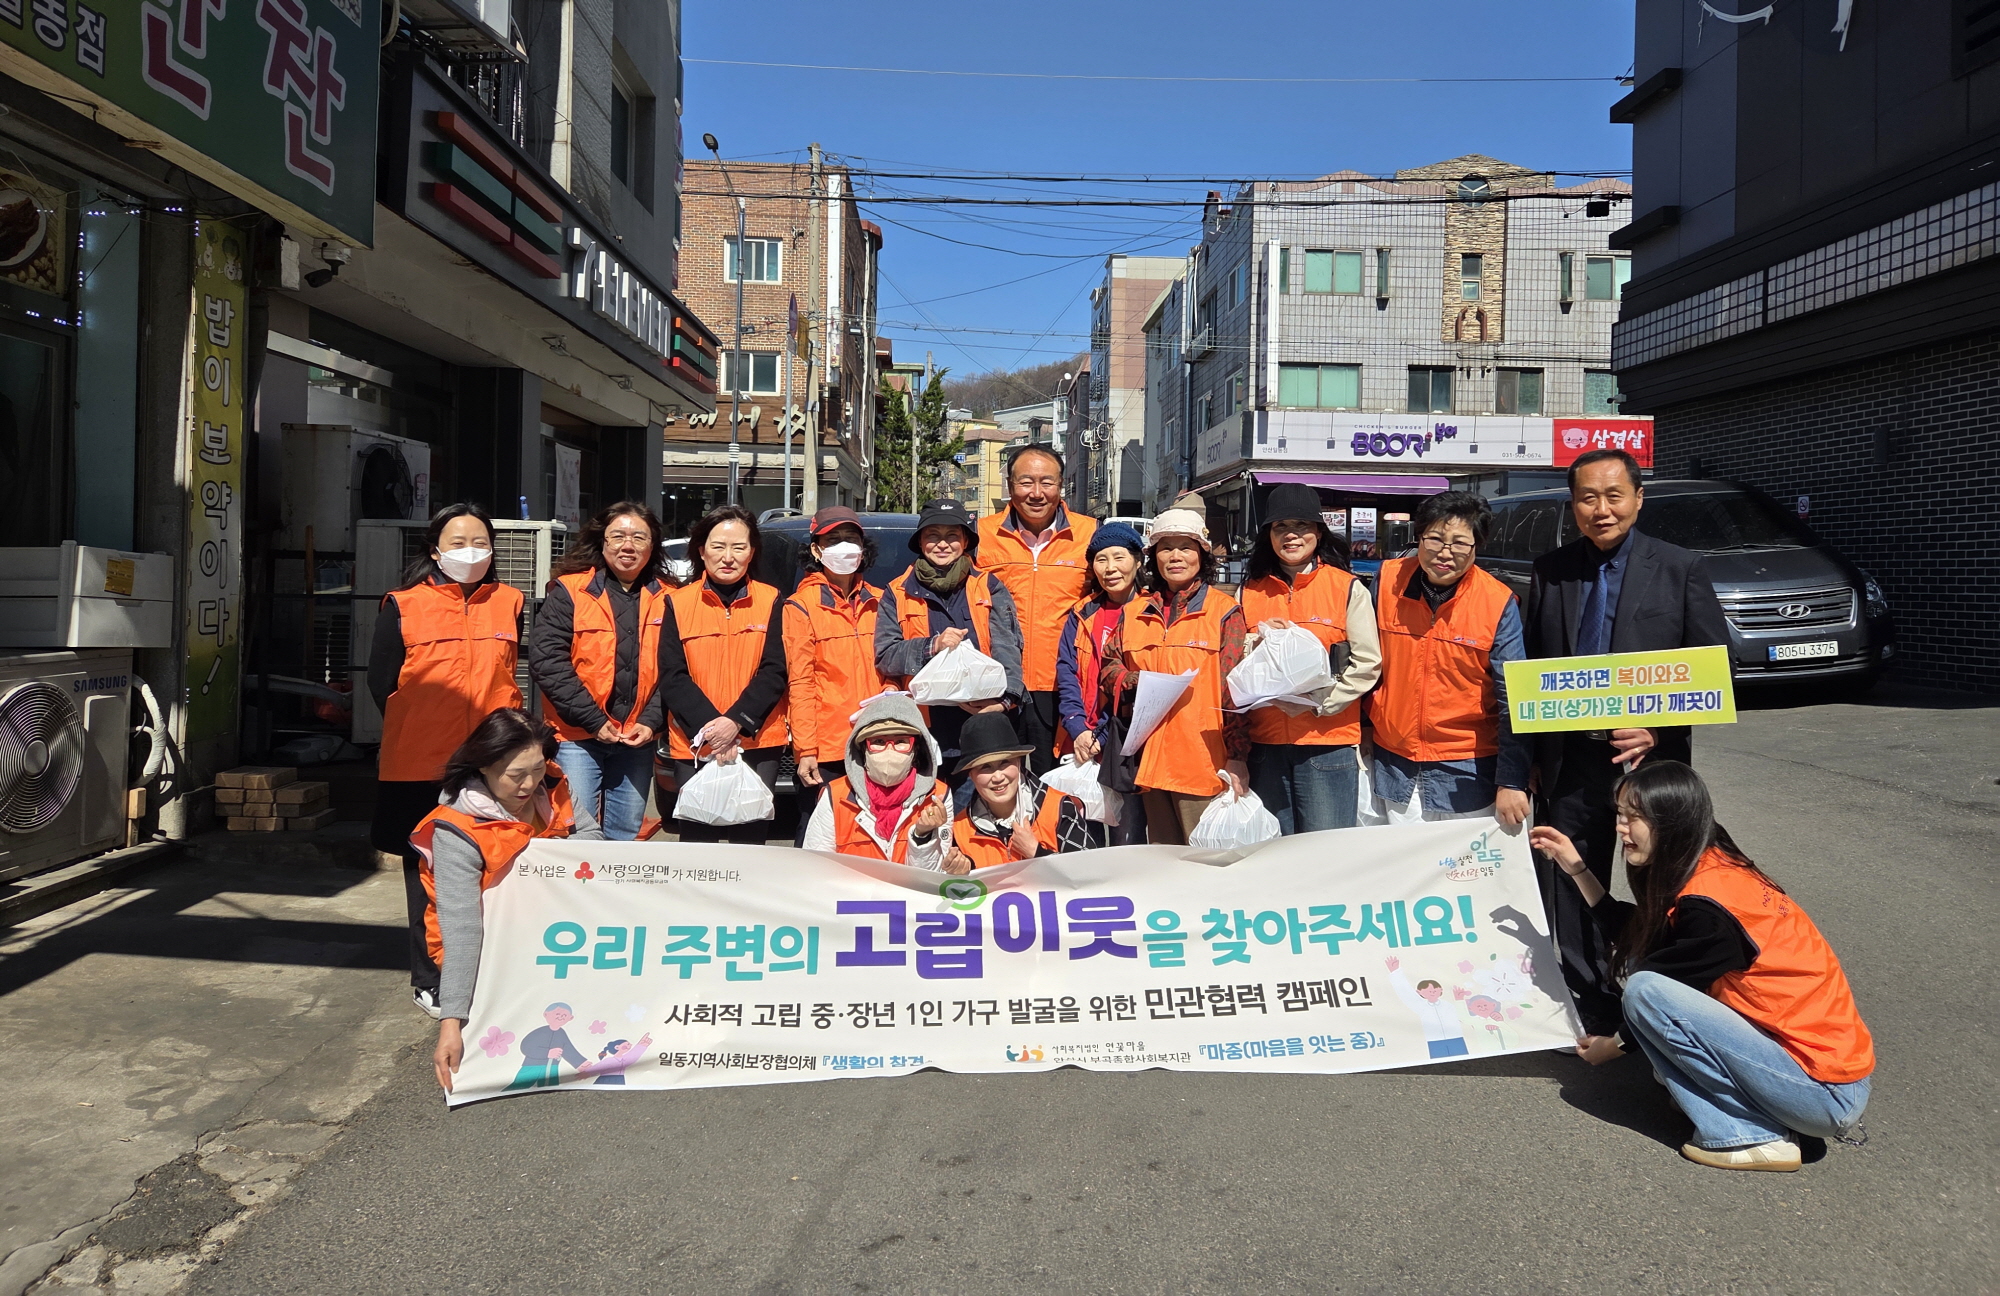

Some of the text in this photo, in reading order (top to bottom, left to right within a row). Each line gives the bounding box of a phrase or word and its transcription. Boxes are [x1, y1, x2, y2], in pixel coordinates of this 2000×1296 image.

[1592, 429, 1646, 450] 삼겹살
[1809, 642, 1836, 656] 3375
[73, 674, 127, 693] SAMSUNG
[1541, 663, 1691, 691] 깨끗하면 복이와요
[1519, 690, 1722, 721] 내 집(상가)앞 내가 깨끗이
[1470, 831, 1505, 869] 일동
[517, 862, 567, 879] 본 사업은
[598, 863, 670, 879] 사랑의열매
[671, 868, 742, 882] 가 지원합니다.
[536, 921, 647, 980] 우리
[661, 925, 820, 982] 주변의
[1201, 894, 1478, 967] 찾아주세요!
[664, 1002, 743, 1027] 사회적
[751, 1002, 801, 1028] 고립
[905, 1000, 943, 1027] 1인
[951, 999, 1000, 1027] 가구
[1008, 995, 1081, 1025] 발굴을
[1088, 994, 1137, 1022] 위한
[1144, 983, 1269, 1020] 민관협력
[1276, 976, 1373, 1013] 캠페인
[1105, 1041, 1146, 1053] 연꽃마을
[1308, 1034, 1346, 1054] 잇는
[658, 1052, 817, 1071] 일동지역사회보장협의체
